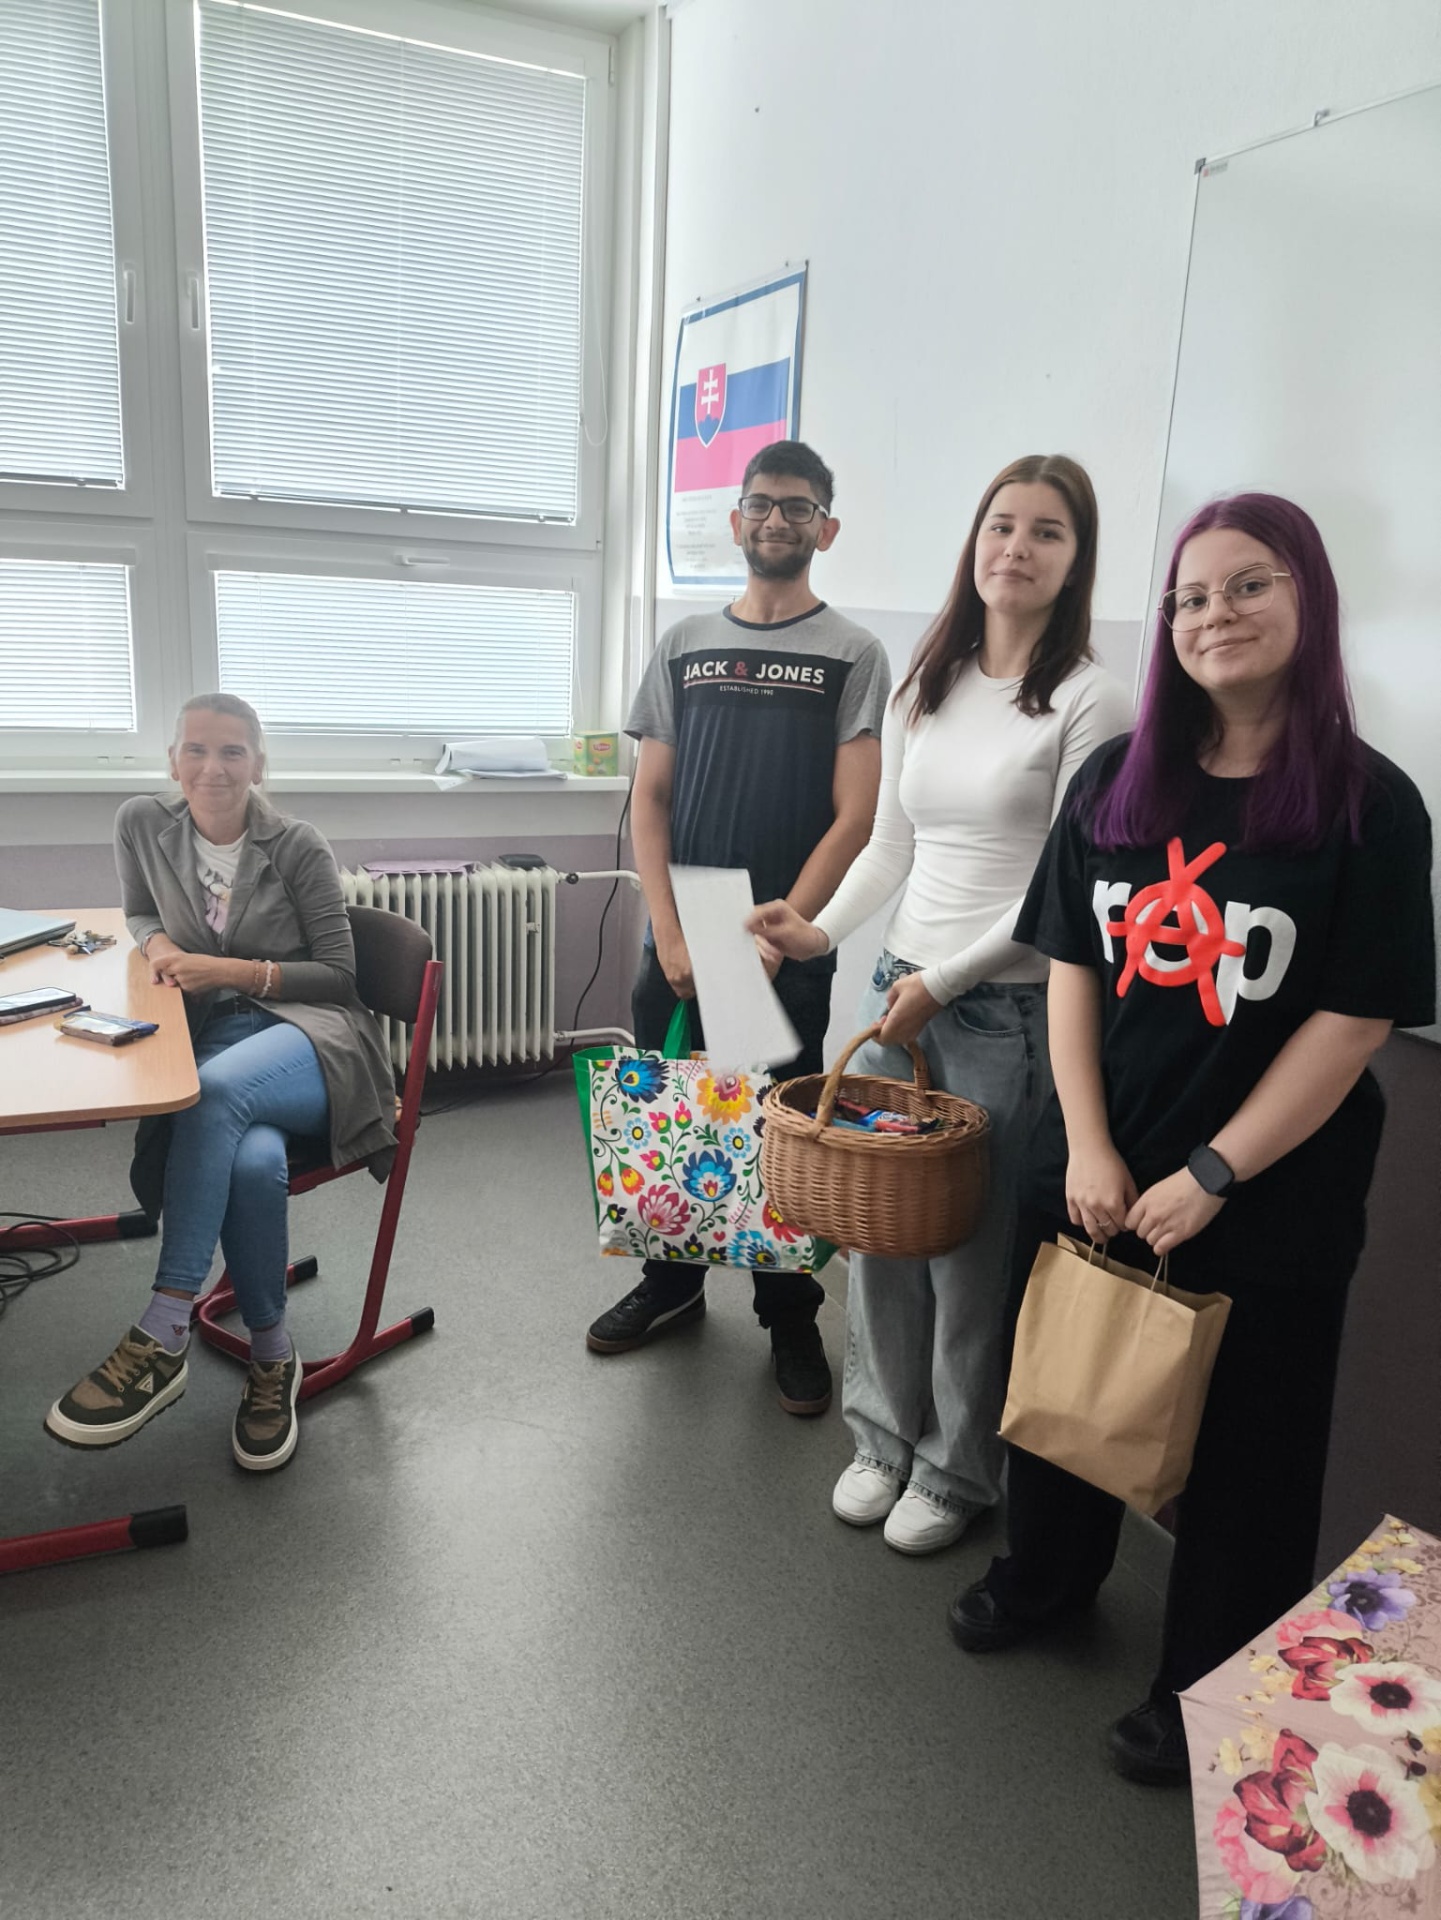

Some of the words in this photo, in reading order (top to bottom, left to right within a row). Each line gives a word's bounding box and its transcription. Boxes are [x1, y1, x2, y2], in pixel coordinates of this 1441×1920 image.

[683, 660, 729, 681] JACK
[734, 661, 748, 676] &
[755, 663, 826, 685] JONES
[719, 685, 759, 695] ESTABLISHED
